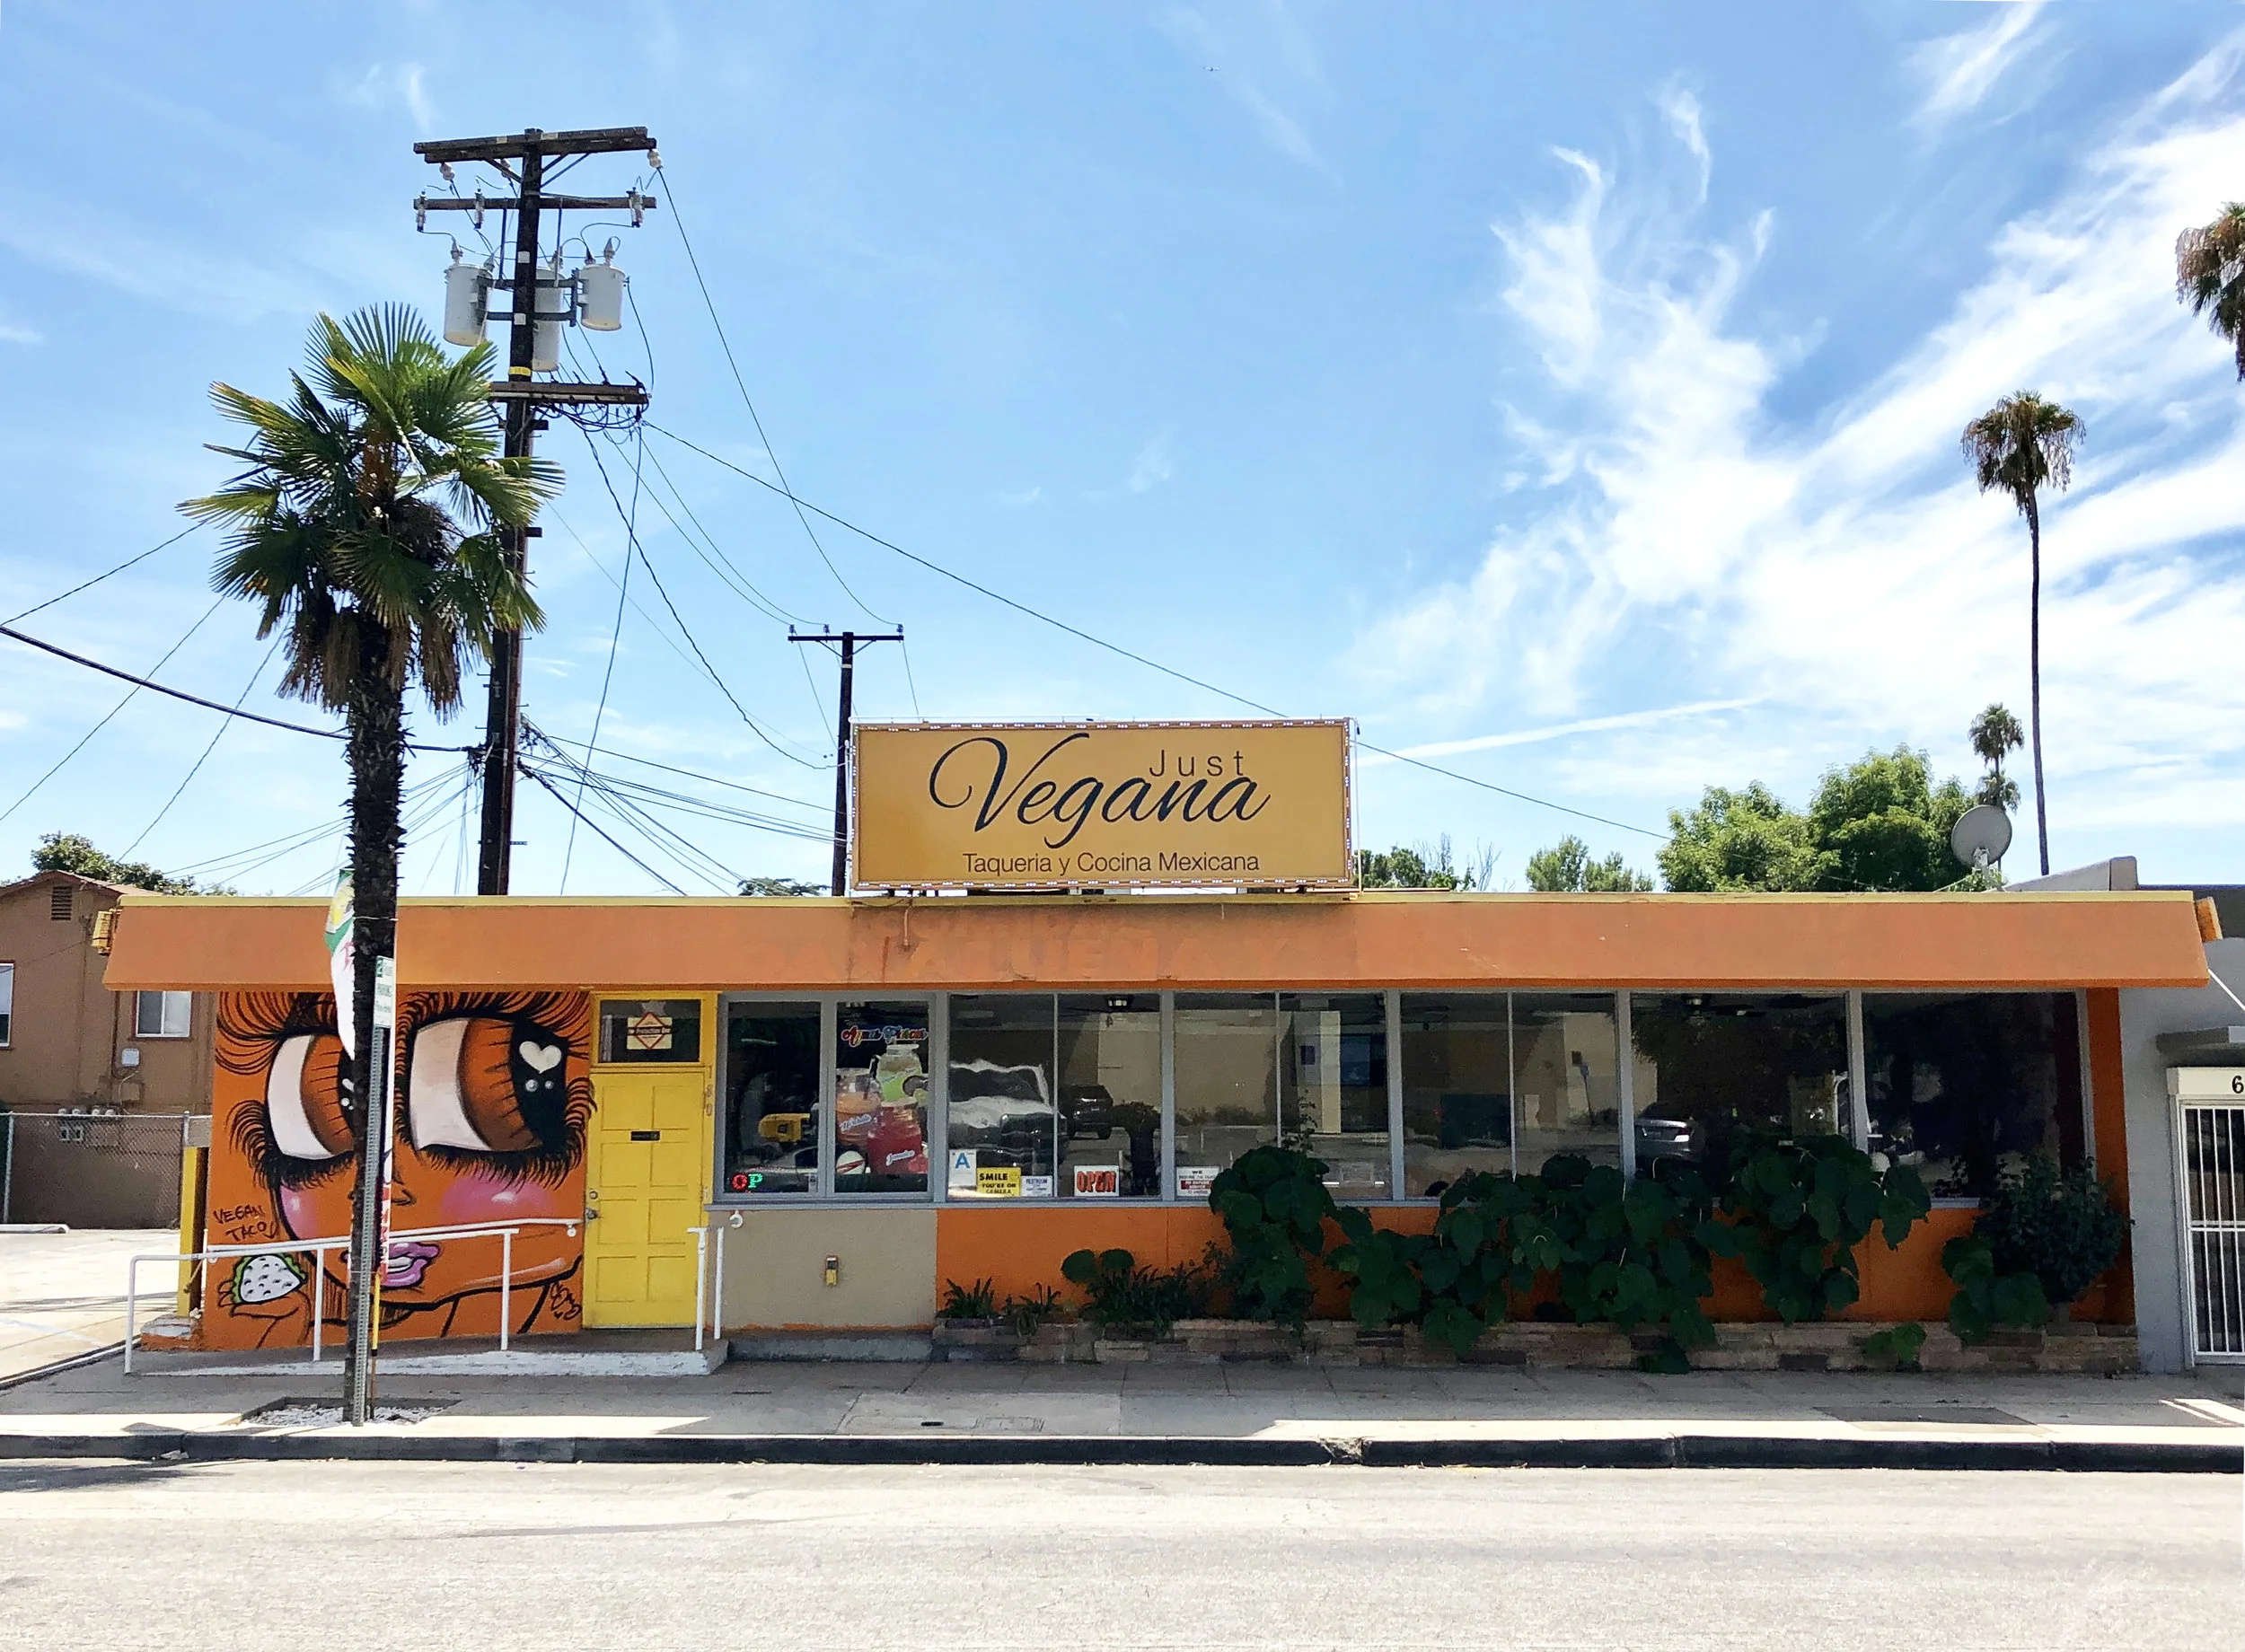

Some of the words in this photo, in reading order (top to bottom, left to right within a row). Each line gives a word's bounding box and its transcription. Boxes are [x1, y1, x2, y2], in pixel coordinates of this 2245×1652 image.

[1149, 749, 1245, 778] Just
[929, 732, 1272, 849] Vegana
[963, 853, 1052, 876] Taqueria
[1058, 857, 1071, 876] y
[1077, 852, 1152, 873] Cocina
[1158, 851, 1260, 873] Mexicana
[2232, 1075, 2245, 1094] 6
[955, 1152, 971, 1169] A
[979, 1173, 1008, 1181] SMILE
[1076, 1170, 1116, 1193] OPEN
[213, 1204, 266, 1225] VEGAN
[225, 1221, 267, 1243] TACO
